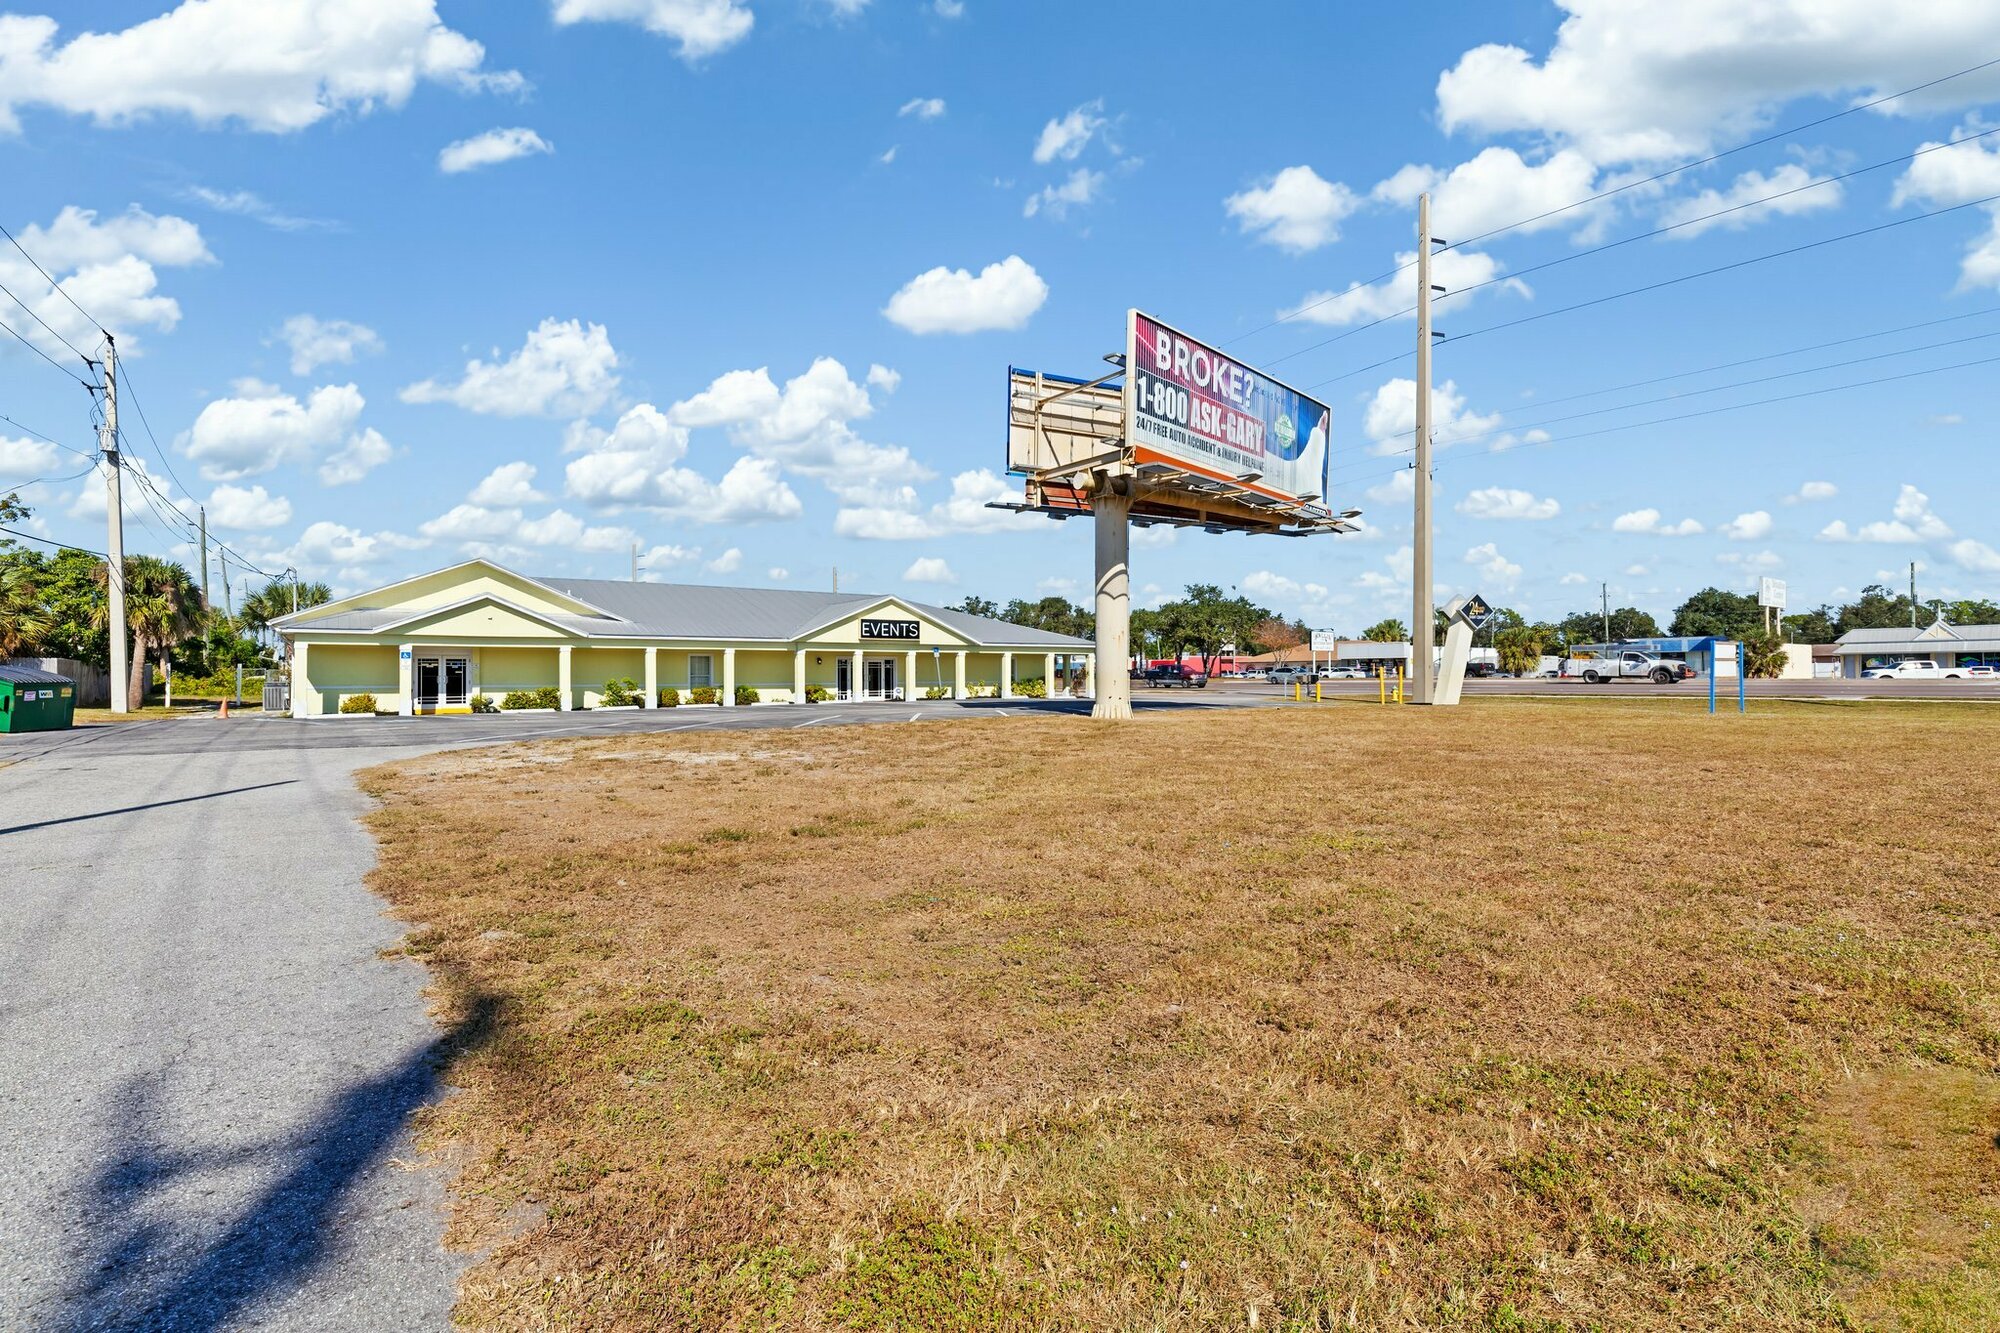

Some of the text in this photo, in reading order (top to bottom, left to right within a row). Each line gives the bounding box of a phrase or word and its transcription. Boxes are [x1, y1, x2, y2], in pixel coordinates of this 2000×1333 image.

[1156, 329, 1254, 409] BROKE?
[1136, 416, 1152, 432] 24/7
[1153, 424, 1168, 438] FREE
[1169, 428, 1187, 444] AUTO
[1188, 435, 1216, 456] ACCIDENT
[1217, 446, 1222, 457] &
[1222, 448, 1241, 465] INJURY
[1138, 376, 1187, 425] 1-800
[1191, 398, 1263, 453] ASK-GARY
[862, 622, 918, 637] EVENTS
